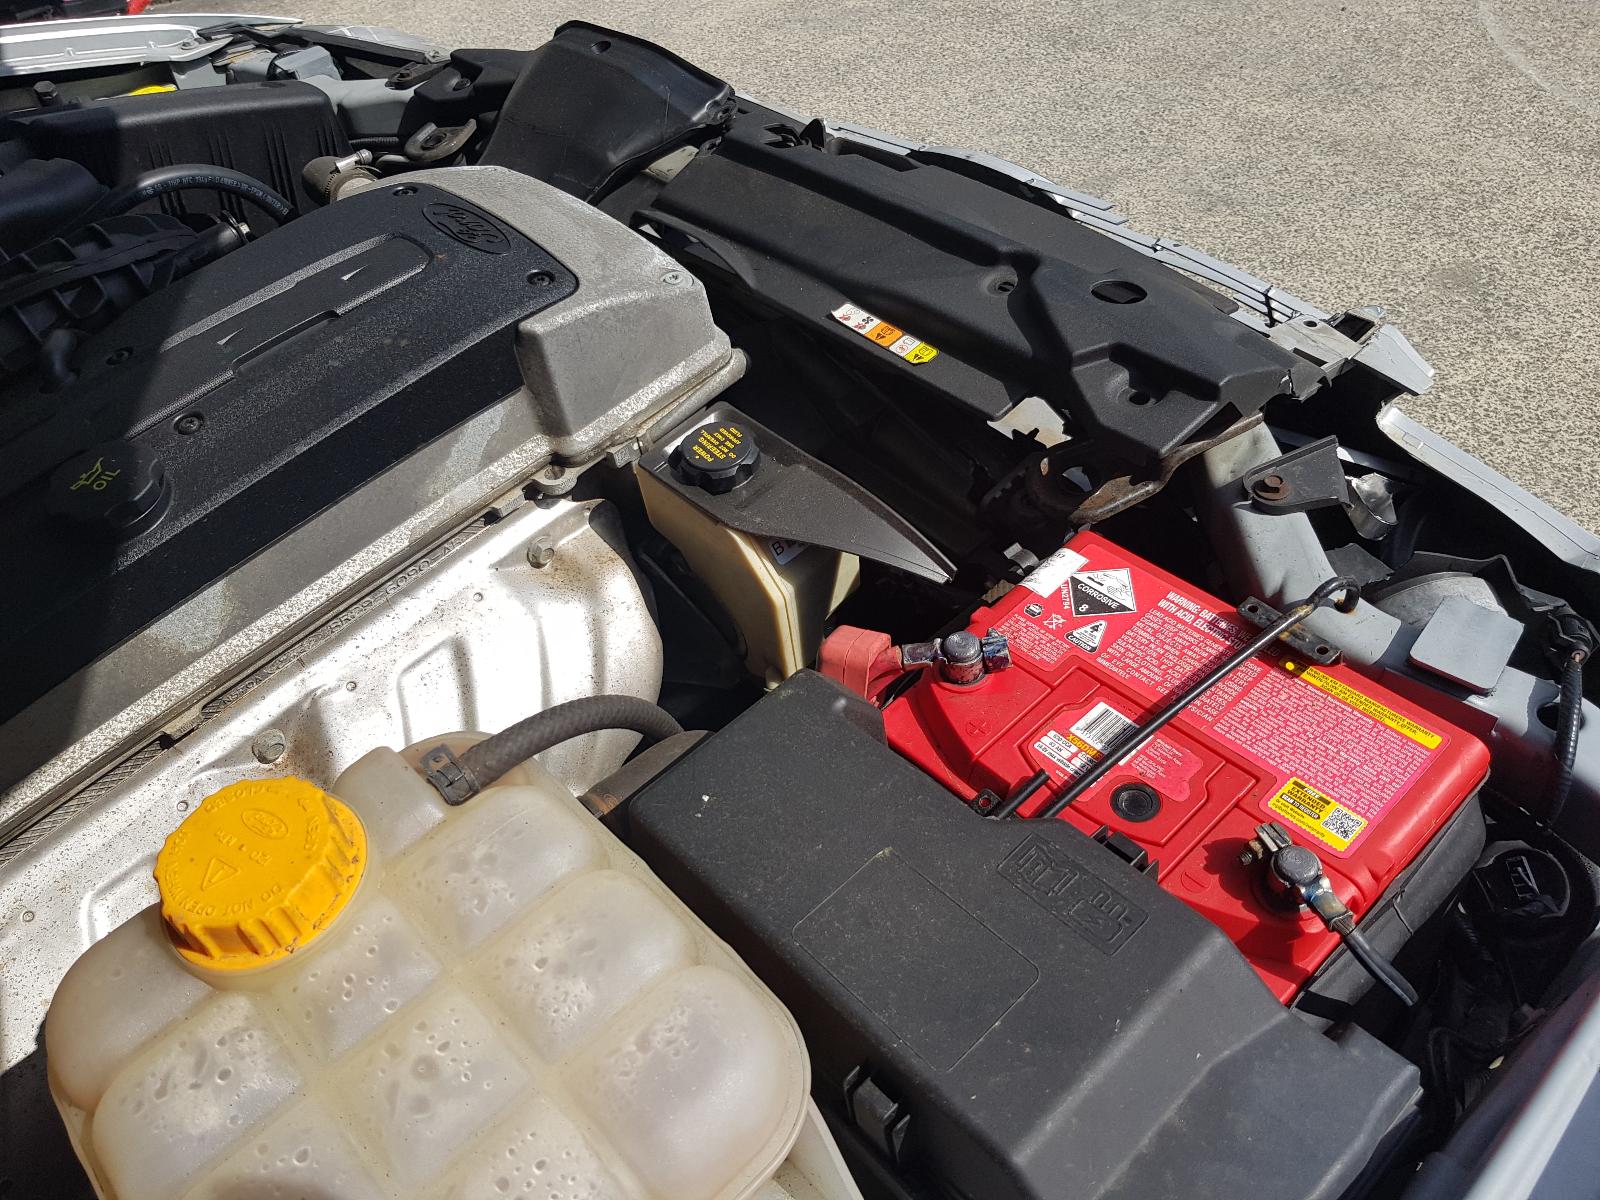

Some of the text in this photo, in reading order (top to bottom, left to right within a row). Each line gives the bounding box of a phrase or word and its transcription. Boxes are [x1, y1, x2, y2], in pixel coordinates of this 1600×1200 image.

[692, 445, 714, 462] POWER
[699, 437, 726, 460] STEERING
[93, 469, 121, 490] OIL
[1060, 584, 1070, 610] UN2794
[1078, 583, 1120, 609] CORROSIVE
[1148, 608, 1165, 619] LEAD
[1162, 616, 1178, 626] ACID
[1175, 623, 1205, 642] BATTERIES
[1157, 598, 1180, 614] WITH
[1174, 608, 1198, 624] ACID,
[1193, 618, 1230, 641] ELECTRIC
[1165, 591, 1203, 614] WARNING:
[1198, 609, 1241, 635] BATTERIES,
[1068, 635, 1092, 651] CAUTION
[1110, 643, 1126, 654] SKIN
[1134, 621, 1156, 635] METAL
[1155, 633, 1183, 650] OBJECTS
[1182, 648, 1202, 661] AWAY
[1139, 617, 1253, 683] CIGARETTES AWAY FROM KEEP
[1162, 623, 1179, 634] KEEP
[1176, 631, 1200, 645] SPARKS
[1197, 642, 1222, 658] FLAMES
[1115, 639, 1146, 658] SULPHURIC
[1166, 668, 1182, 679] ACID
[1124, 630, 1150, 646] BATTERY
[1163, 652, 1195, 671] ENCLOSED
[1213, 680, 1240, 697] ROVIDE
[1159, 657, 1175, 667] THIS
[1162, 644, 1181, 656] WHEN
[1181, 655, 1212, 674] CHARGING
[1223, 679, 1244, 693] USING
[1105, 648, 1122, 658] WITH
[1120, 656, 1140, 669] LARGE
[1138, 667, 1164, 683] AMOUNT
[1202, 704, 1220, 716] CASE
[1111, 659, 1126, 668] EYE
[1155, 685, 1171, 696] SEE
[1062, 740, 1073, 749] CCA
[1281, 795, 1295, 803] SCAN
[1297, 805, 1321, 819] REGISTER
[1284, 790, 1326, 814] WARRANTY
[1288, 787, 1329, 809] EXTENDED
[223, 898, 255, 917] NOT
